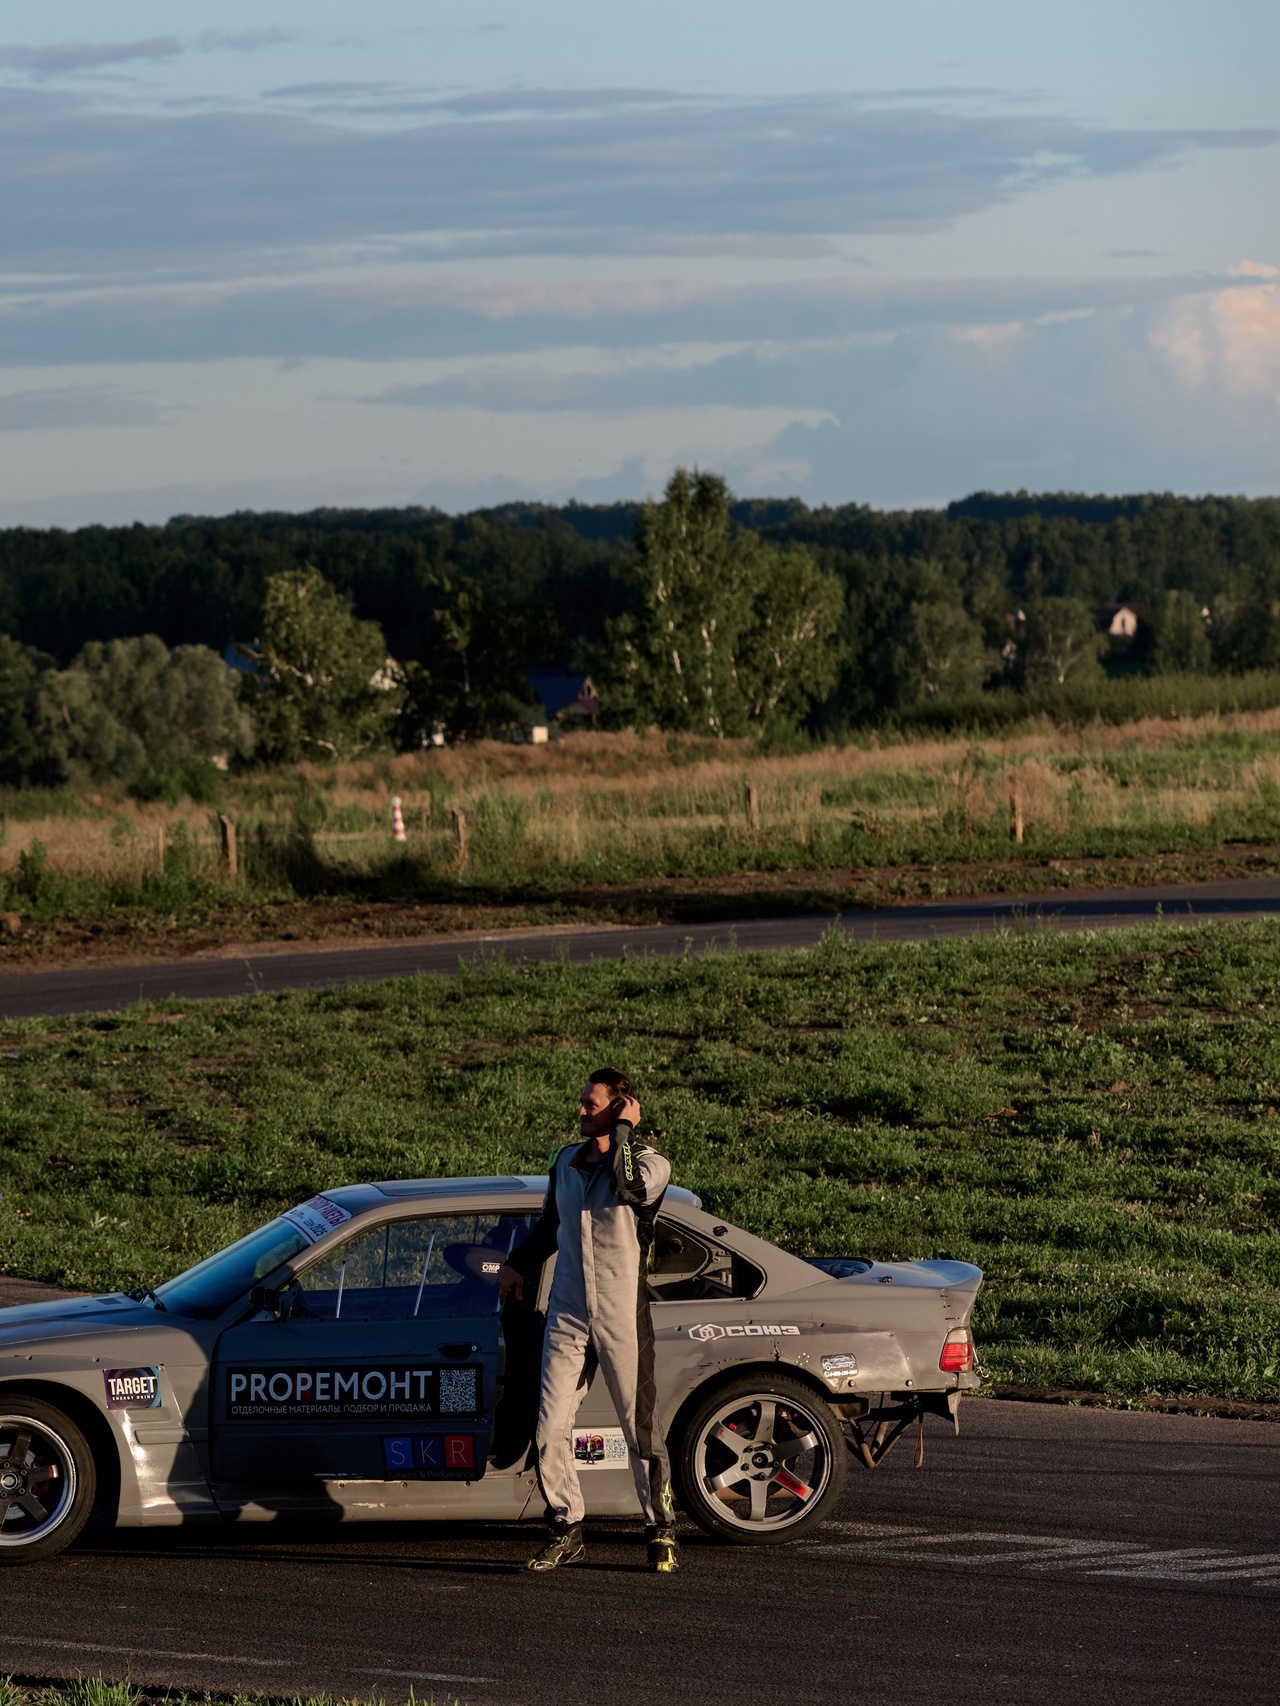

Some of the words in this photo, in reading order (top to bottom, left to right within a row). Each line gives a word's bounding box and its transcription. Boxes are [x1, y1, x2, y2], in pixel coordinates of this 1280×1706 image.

[482, 1264, 501, 1273] OMP
[725, 1325, 801, 1336] СОЮЗ
[107, 1376, 157, 1396] TARGET
[231, 1404, 287, 1415] ОТДЕЛОЧНЫЕ
[343, 1404, 378, 1415] ПОДБОР
[380, 1404, 387, 1412] И
[389, 1403, 432, 1413] ПРОДАЖА
